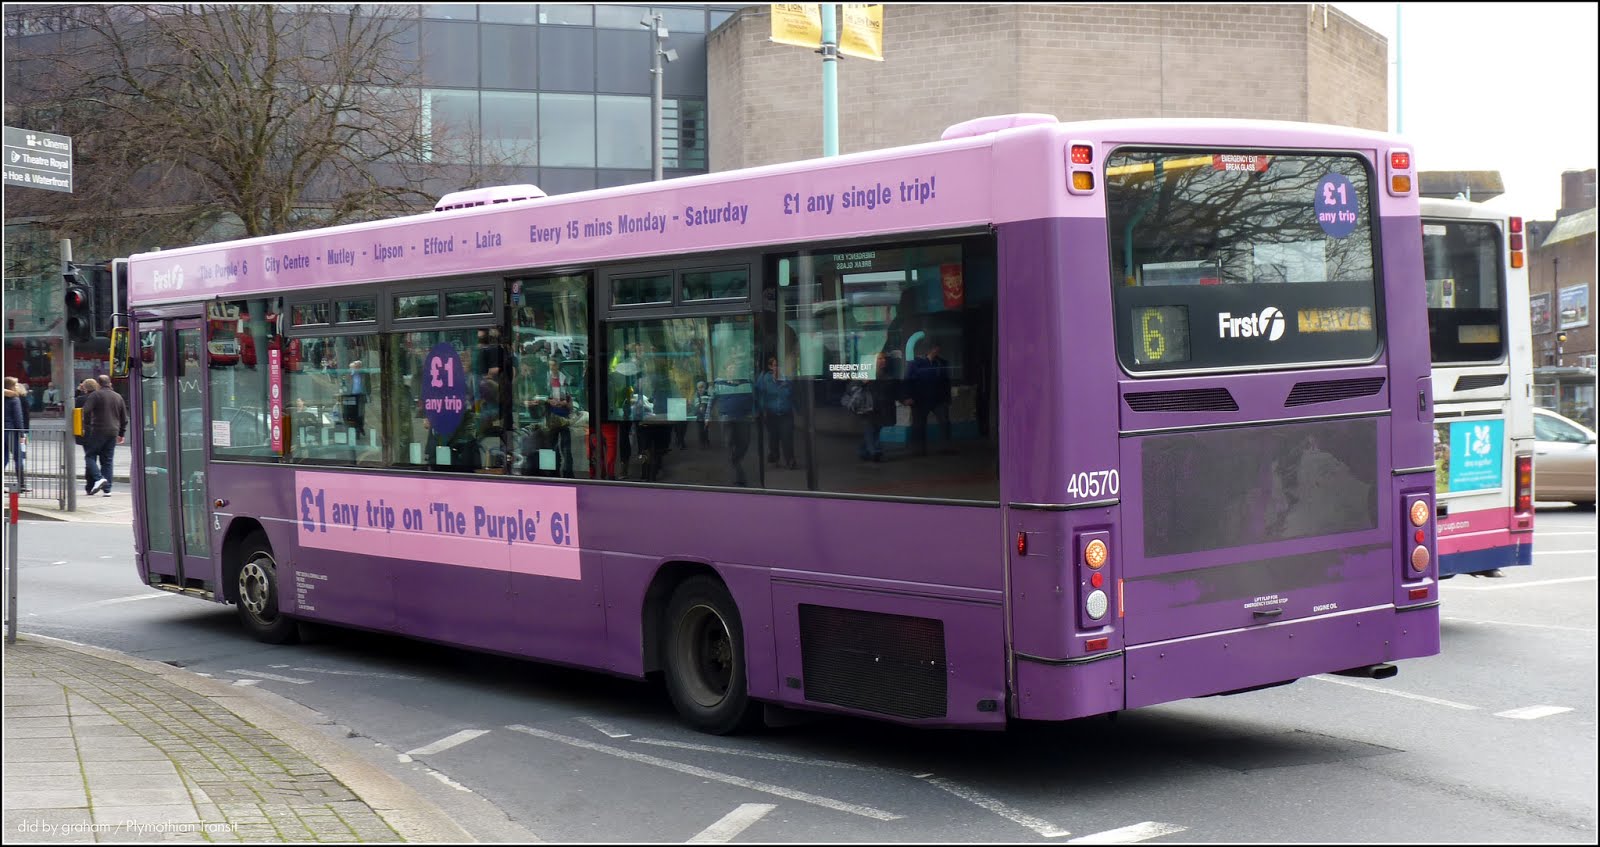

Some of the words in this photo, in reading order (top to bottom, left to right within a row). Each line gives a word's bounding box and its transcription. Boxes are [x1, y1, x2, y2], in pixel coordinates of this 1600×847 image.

[43, 138, 69, 150] Cinema
[22, 153, 49, 166] Theatre
[50, 157, 69, 169] Royal
[1221, 154, 1248, 163] EMERGENCY
[1248, 155, 1258, 163] EXIT
[1225, 163, 1240, 171] BREAK
[8, 170, 24, 181] Hoe
[24, 172, 31, 182] &
[32, 174, 69, 188] Waterfront
[784, 192, 800, 215] £1
[807, 193, 835, 213] any
[842, 182, 892, 209] single
[900, 176, 936, 205] trip!
[1322, 182, 1347, 206] £1
[530, 224, 562, 245] Every
[566, 220, 579, 240] 15
[584, 218, 613, 238] mins
[618, 211, 667, 235] Monday
[685, 202, 749, 227] Saturday
[1319, 213, 1337, 224] any
[1338, 210, 1356, 224] trip
[265, 256, 281, 275] City
[283, 253, 310, 271] Centre
[327, 247, 355, 267] Mutley
[374, 243, 404, 262] Lipson
[424, 236, 454, 255] Efford
[476, 231, 502, 249] Laira
[243, 260, 249, 276] 6
[1218, 311, 1259, 338] First
[1142, 309, 1165, 360] 6
[429, 356, 454, 388] £1
[829, 363, 859, 371] EMERGENCY
[860, 363, 873, 371] EXIT
[832, 372, 850, 380] BREAK
[851, 371, 869, 380] GLASS
[425, 398, 443, 413] any
[444, 395, 462, 413] trip
[1067, 469, 1120, 499] 40570
[300, 486, 328, 533] £1
[332, 502, 359, 531] any
[366, 499, 395, 534] trip
[402, 508, 423, 531] on
[429, 502, 466, 535] ‘The
[474, 505, 541, 546] Purple’
[551, 511, 571, 546] 6!
[1313, 603, 1330, 612] ENGINE
